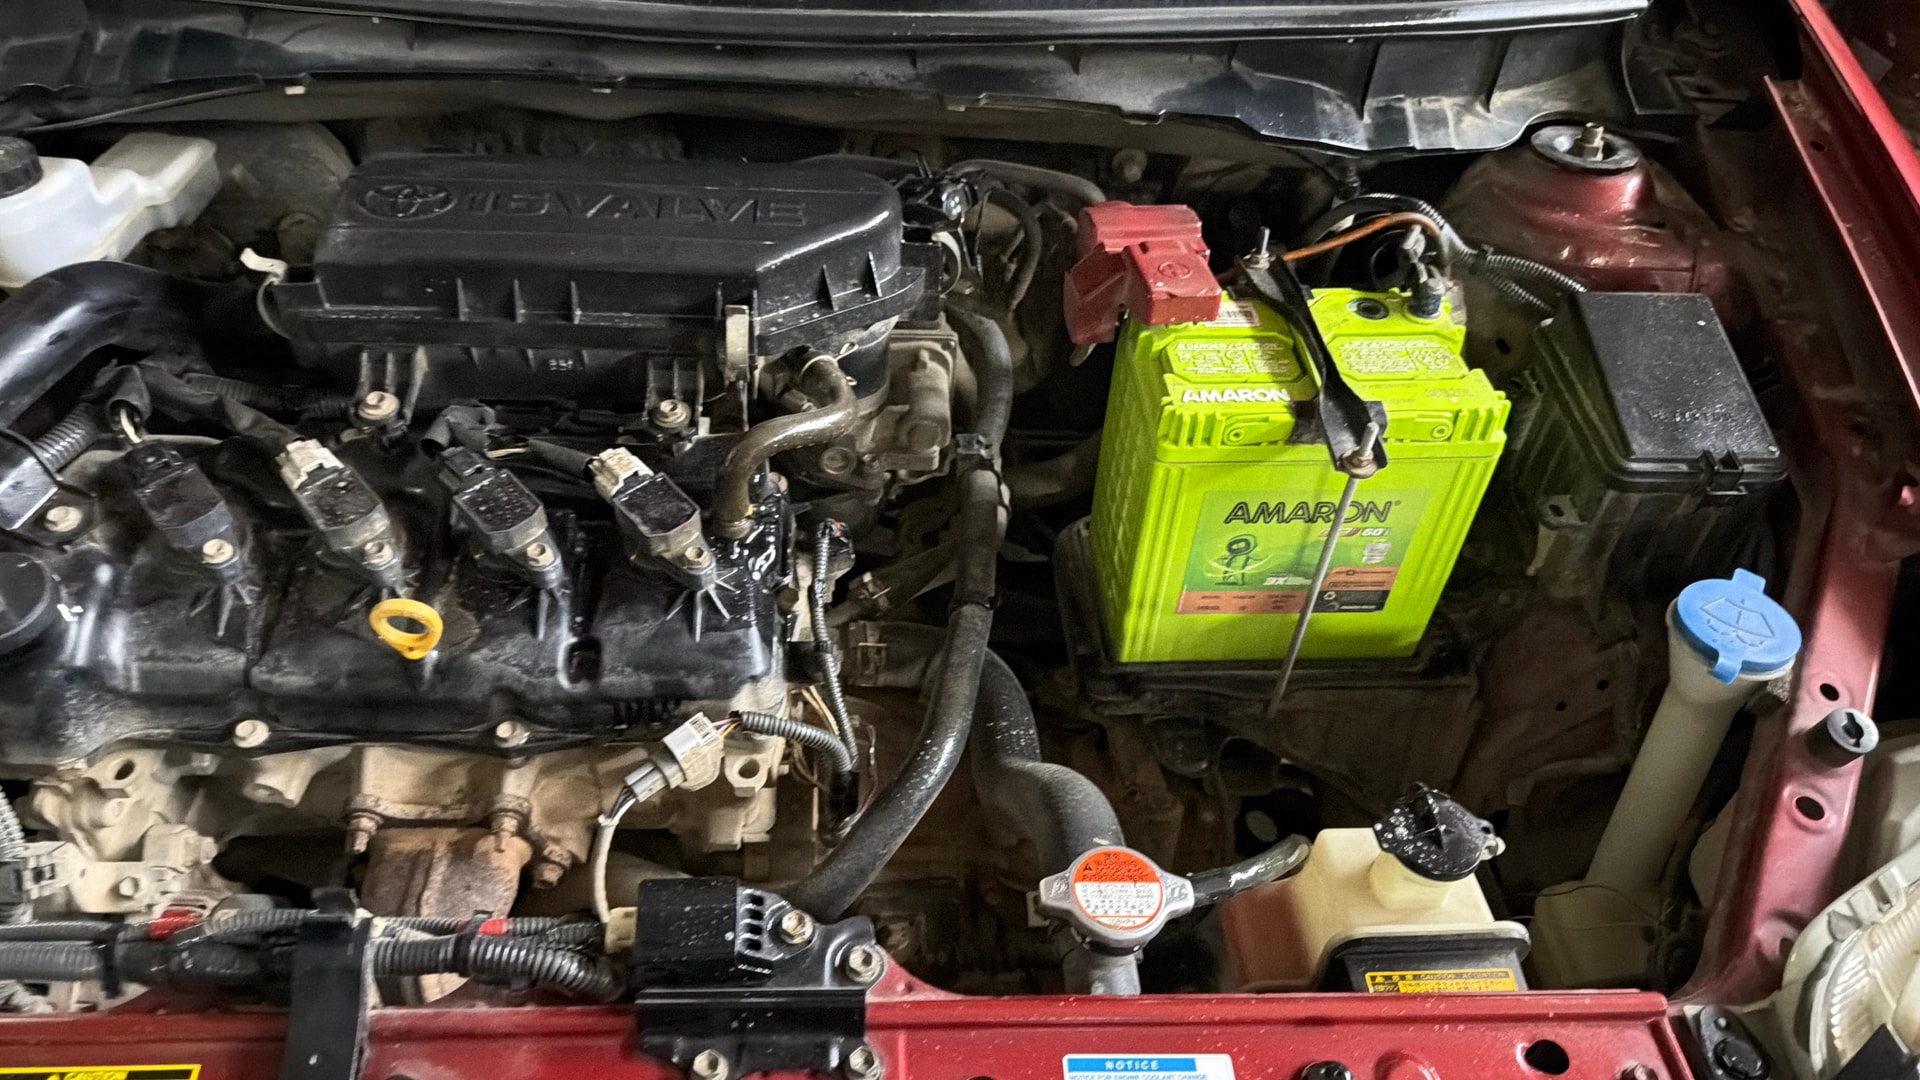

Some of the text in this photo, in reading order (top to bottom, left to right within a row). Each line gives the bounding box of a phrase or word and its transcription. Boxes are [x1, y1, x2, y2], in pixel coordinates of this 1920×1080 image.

[1182, 388, 1291, 402] AMARON
[1223, 500, 1392, 524] AMARON
[1105, 1061, 1159, 1070] NOTICE
